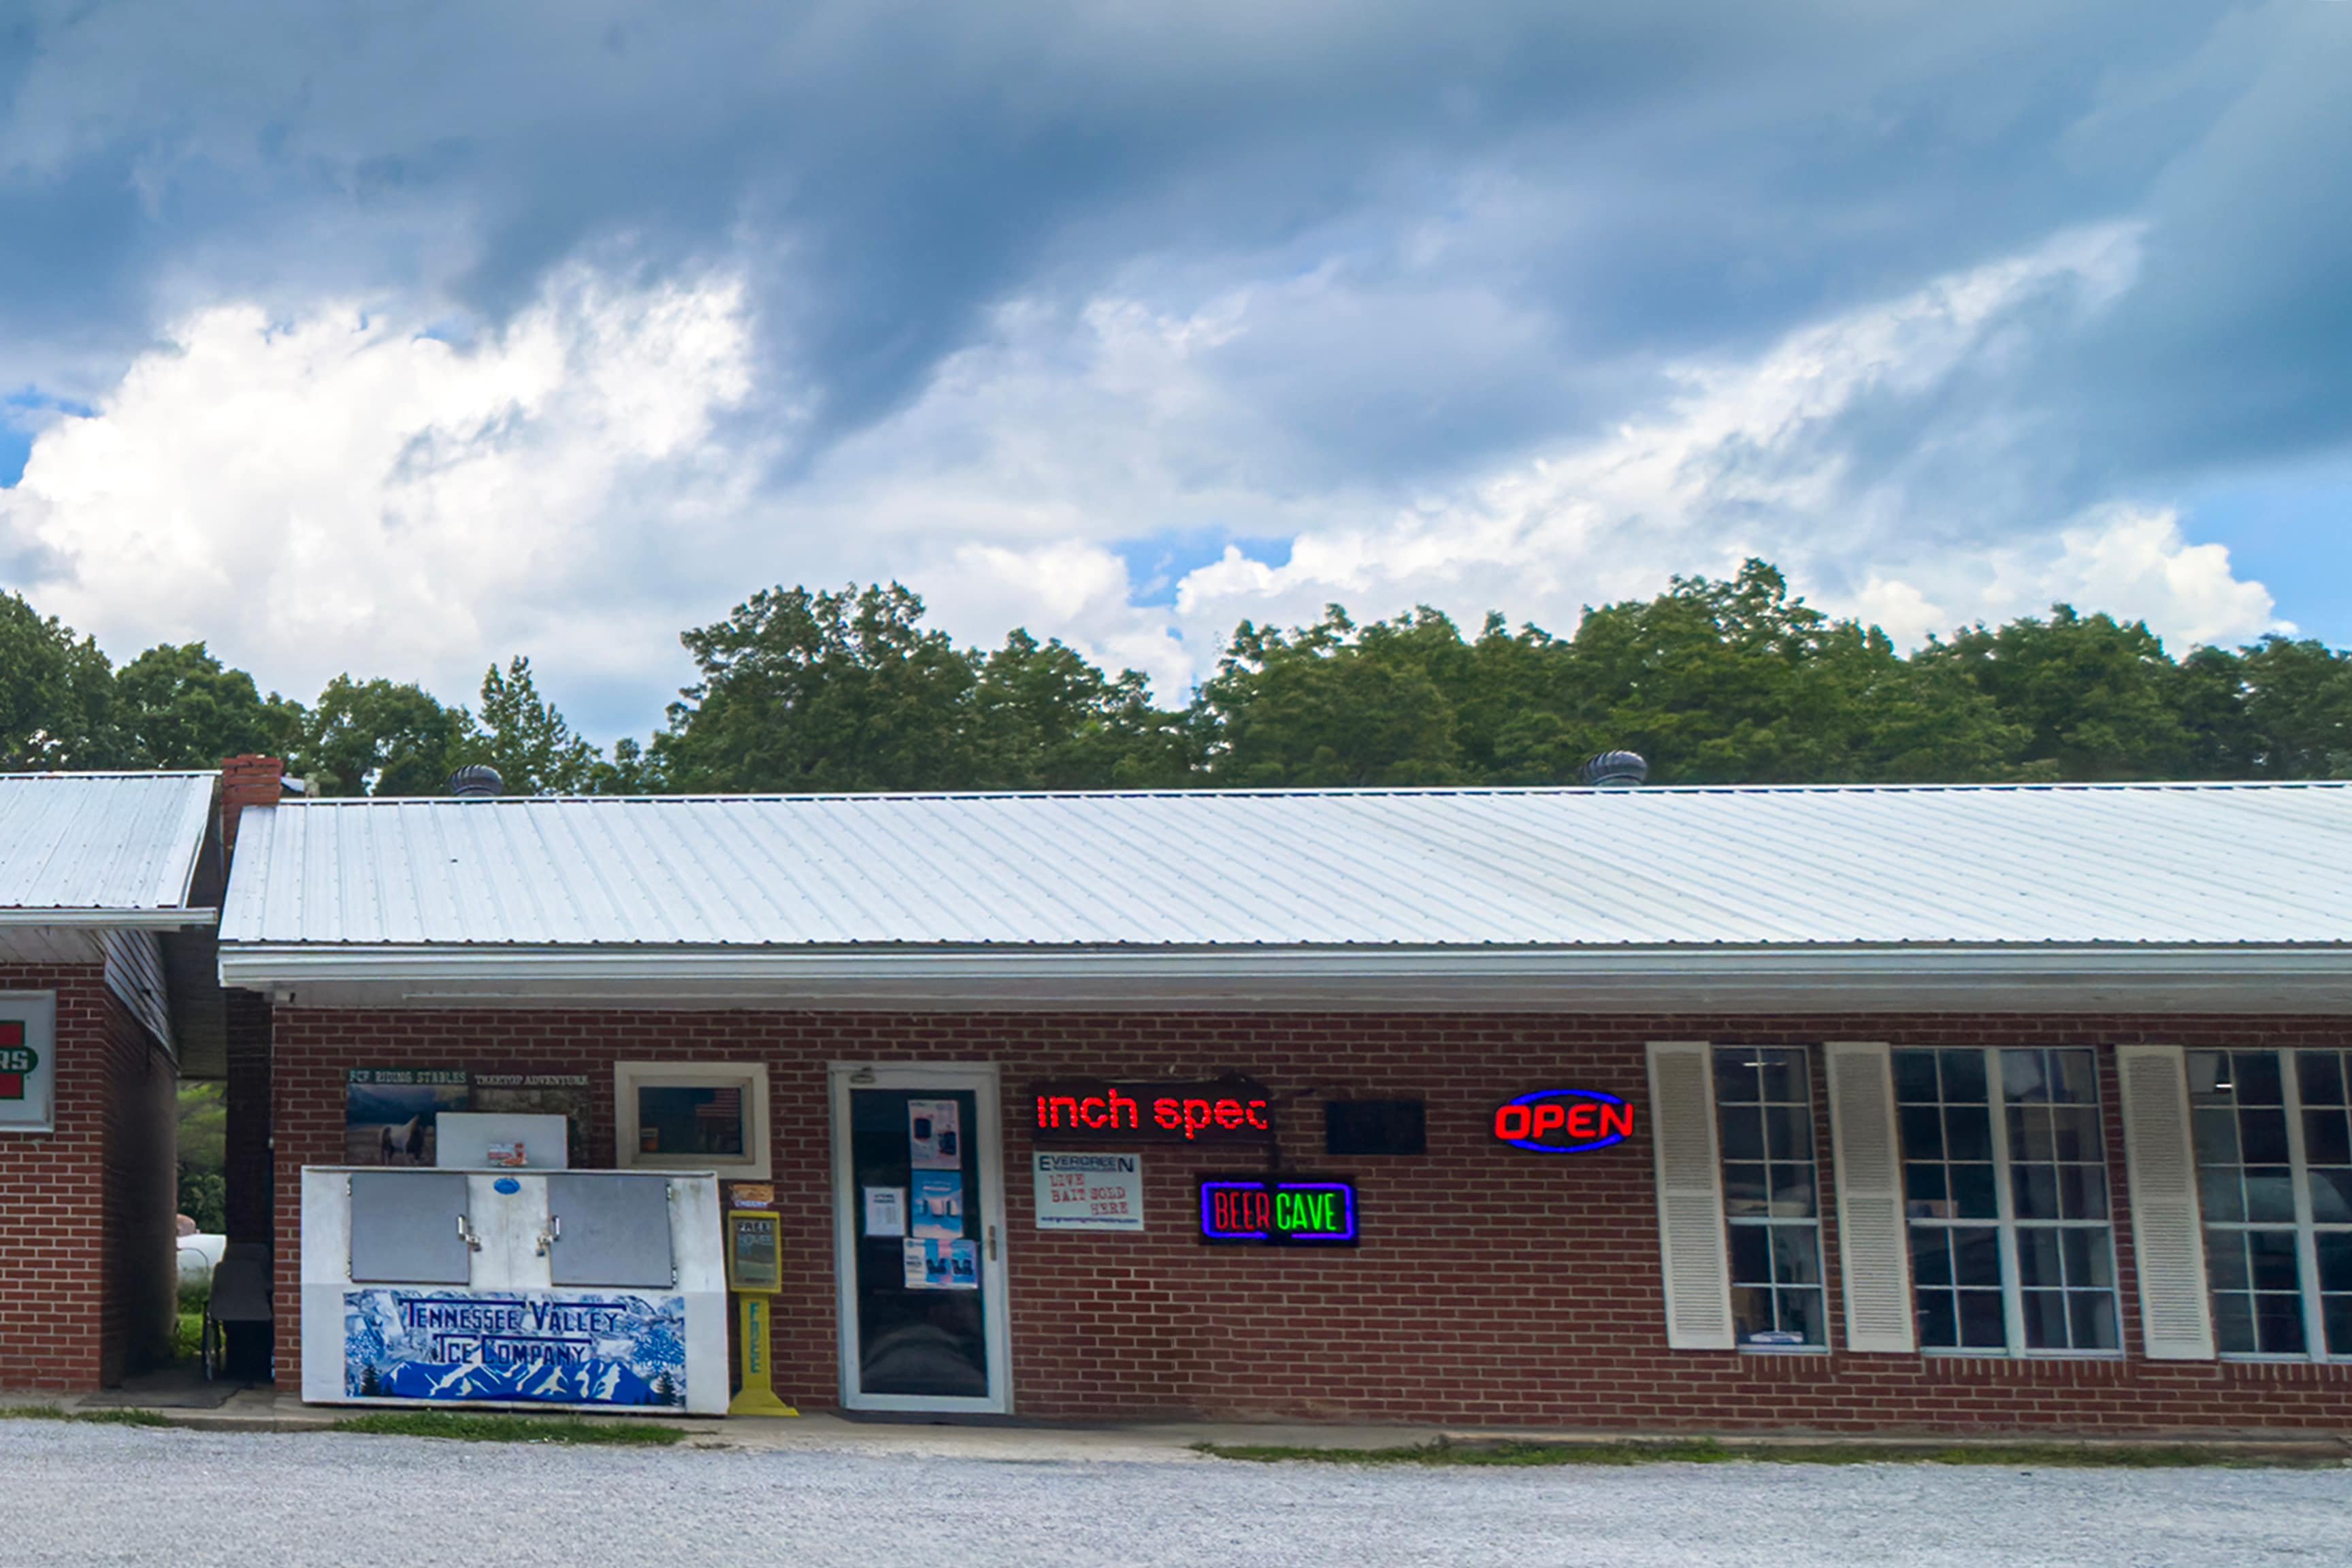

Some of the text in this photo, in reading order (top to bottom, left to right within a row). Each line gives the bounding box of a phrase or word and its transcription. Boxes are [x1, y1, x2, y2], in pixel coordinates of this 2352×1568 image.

[376, 1071, 412, 1083] RIDING
[416, 1072, 466, 1083] STABLES
[1494, 1102, 1634, 1140] OPEN
[1039, 1155, 1134, 1173] EVERGREEN
[1050, 1173, 1084, 1187] LIVE
[1051, 1187, 1126, 1203] BAIT SOLD
[1091, 1202, 1128, 1215] HERE
[1215, 1192, 1337, 1230] BEER CAVE
[397, 1298, 627, 1333] TENNESSEE VALLEY
[432, 1334, 592, 1366] ICE COMPANY
[750, 1303, 761, 1373] FREE
